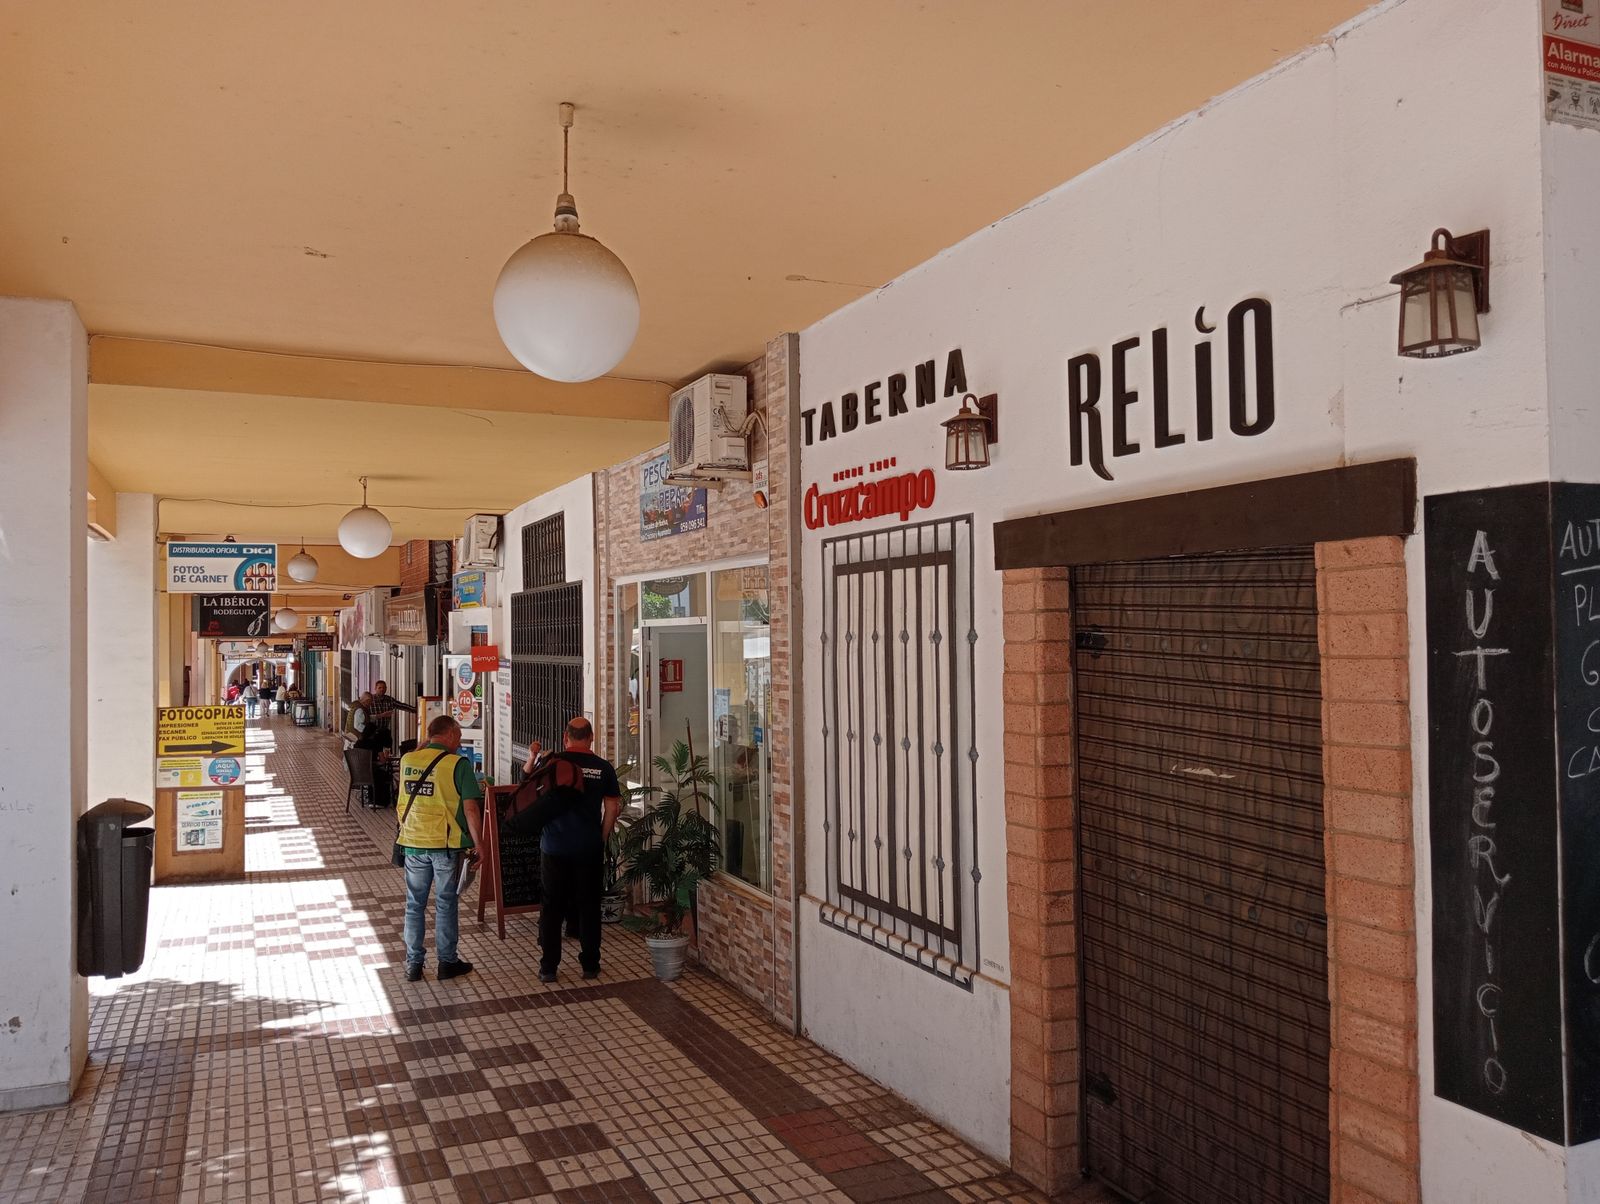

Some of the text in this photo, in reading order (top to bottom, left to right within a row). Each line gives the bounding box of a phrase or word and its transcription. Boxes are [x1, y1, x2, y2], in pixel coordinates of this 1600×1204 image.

[1552, 11, 1593, 31] Direct
[1547, 61, 1559, 69] con
[1560, 63, 1577, 73] Aviso
[801, 348, 968, 446] TABERNA
[804, 468, 936, 530] Cruzcampo
[173, 566, 205, 574] FOTOS
[173, 575, 228, 583] DE CARNET
[203, 595, 266, 607] LA IBÉRICA
[159, 707, 244, 721] FOTOCOPIAS
[1452, 530, 1511, 1094] AUTOSERVICIO
